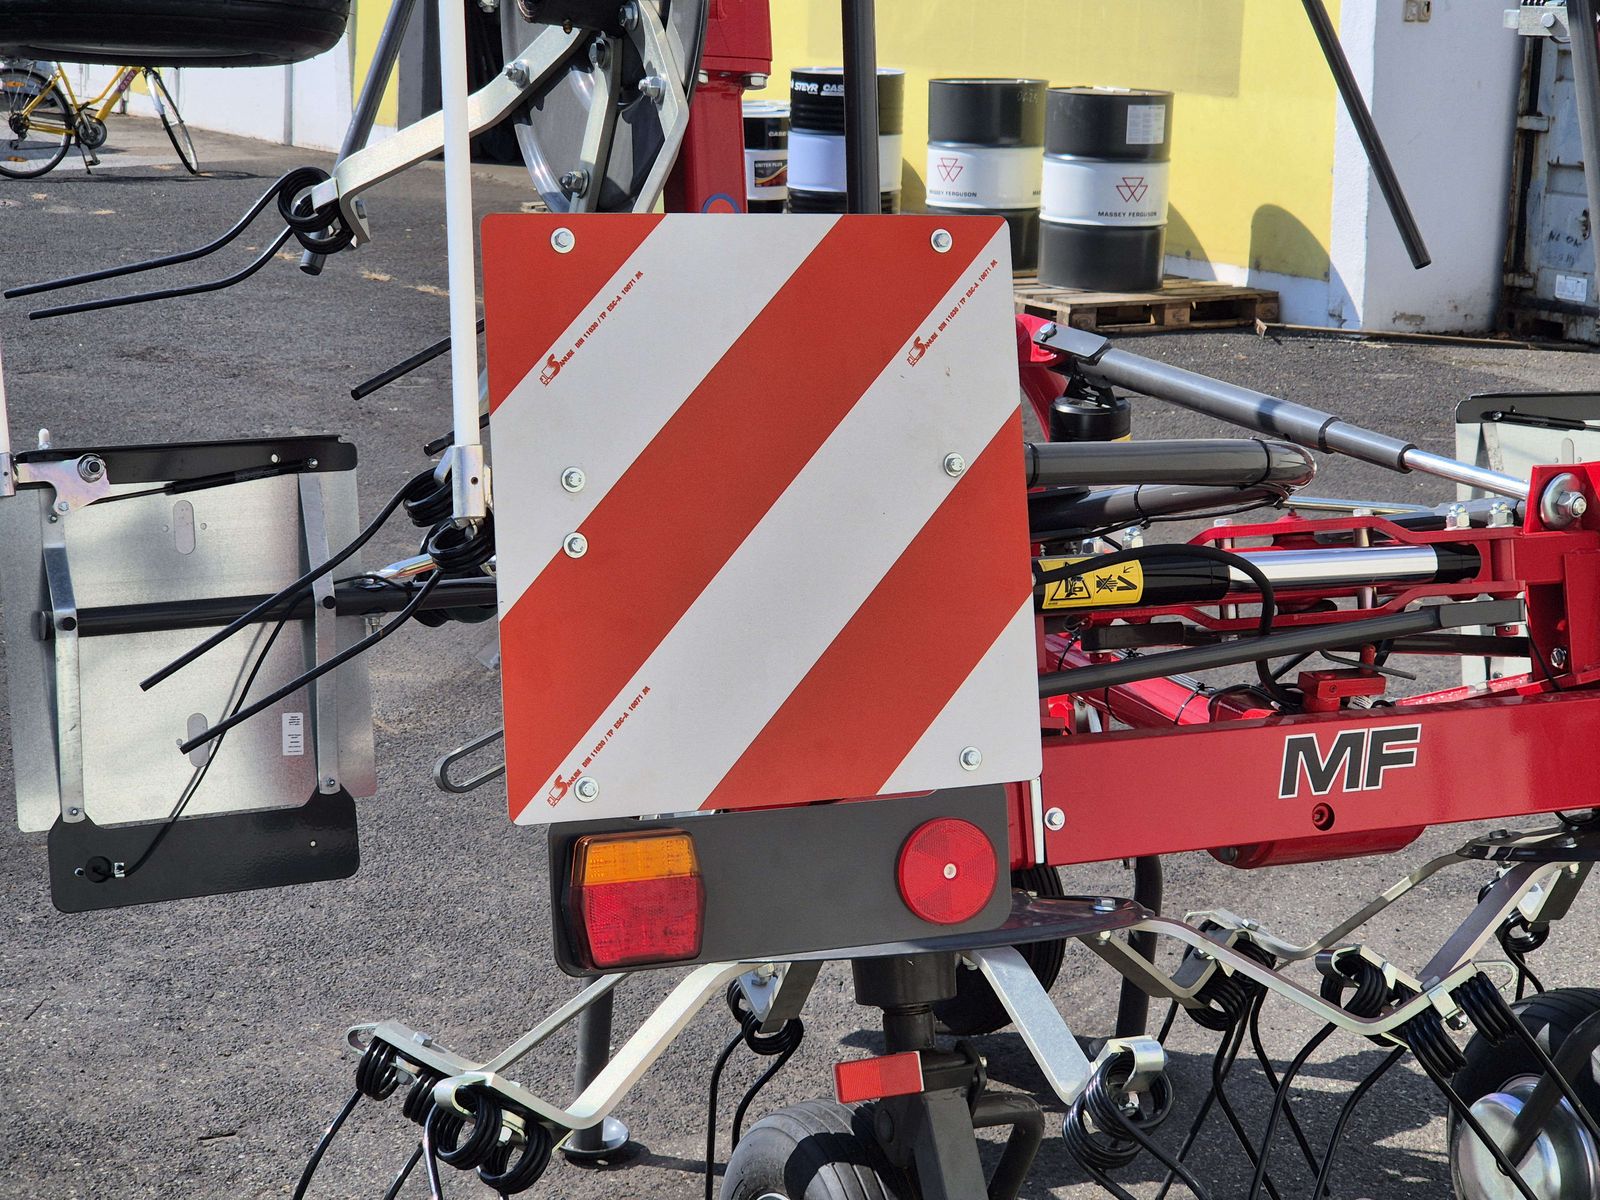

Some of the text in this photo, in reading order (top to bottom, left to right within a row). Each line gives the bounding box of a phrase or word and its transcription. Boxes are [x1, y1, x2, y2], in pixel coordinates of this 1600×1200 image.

[795, 81, 818, 93] STEYR
[822, 84, 845, 93] CAS
[1278, 723, 1422, 800] MF
